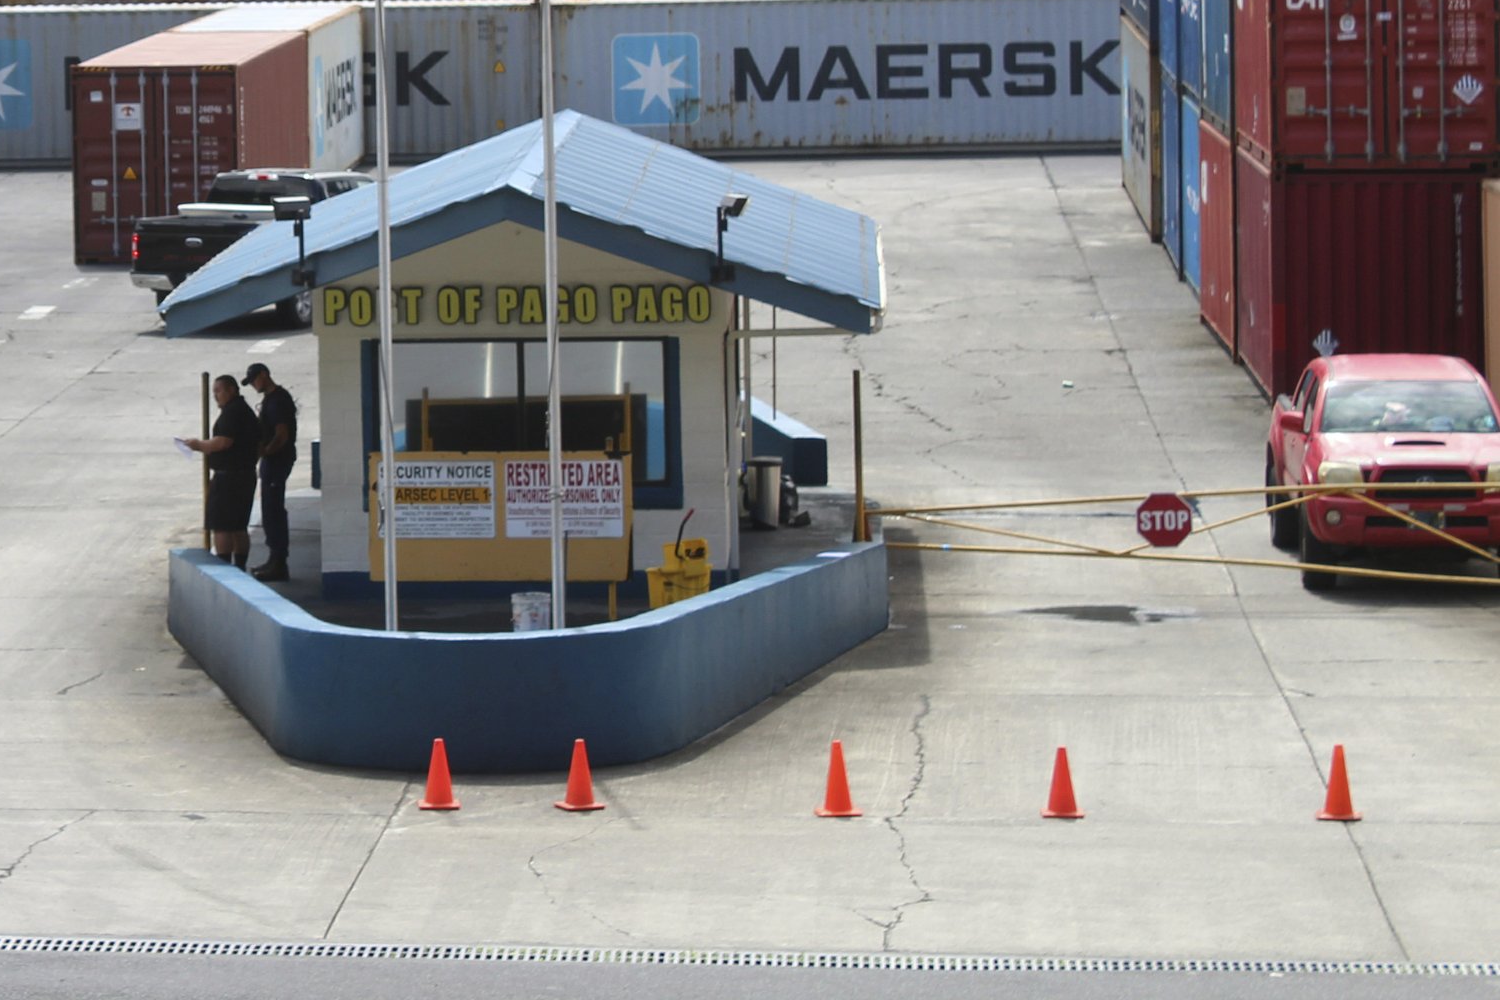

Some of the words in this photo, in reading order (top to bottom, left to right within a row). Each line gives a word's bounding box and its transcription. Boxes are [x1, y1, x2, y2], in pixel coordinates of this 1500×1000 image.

[733, 40, 1121, 101] MAERSK
[438, 286, 482, 325] OF
[497, 286, 597, 324] PAGO
[611, 285, 711, 323] PAGO
[380, 466, 441, 479] CURITY
[446, 465, 491, 478] NOTICE
[507, 463, 584, 486] RESTRITED
[587, 464, 620, 486] AREA
[395, 488, 437, 501] ARSEC
[440, 488, 479, 500] LEVEL
[507, 488, 551, 503] AUTHORIZE
[561, 488, 599, 503] RSONNEL
[602, 488, 620, 503] ONLY
[1140, 511, 1188, 531] STOP
